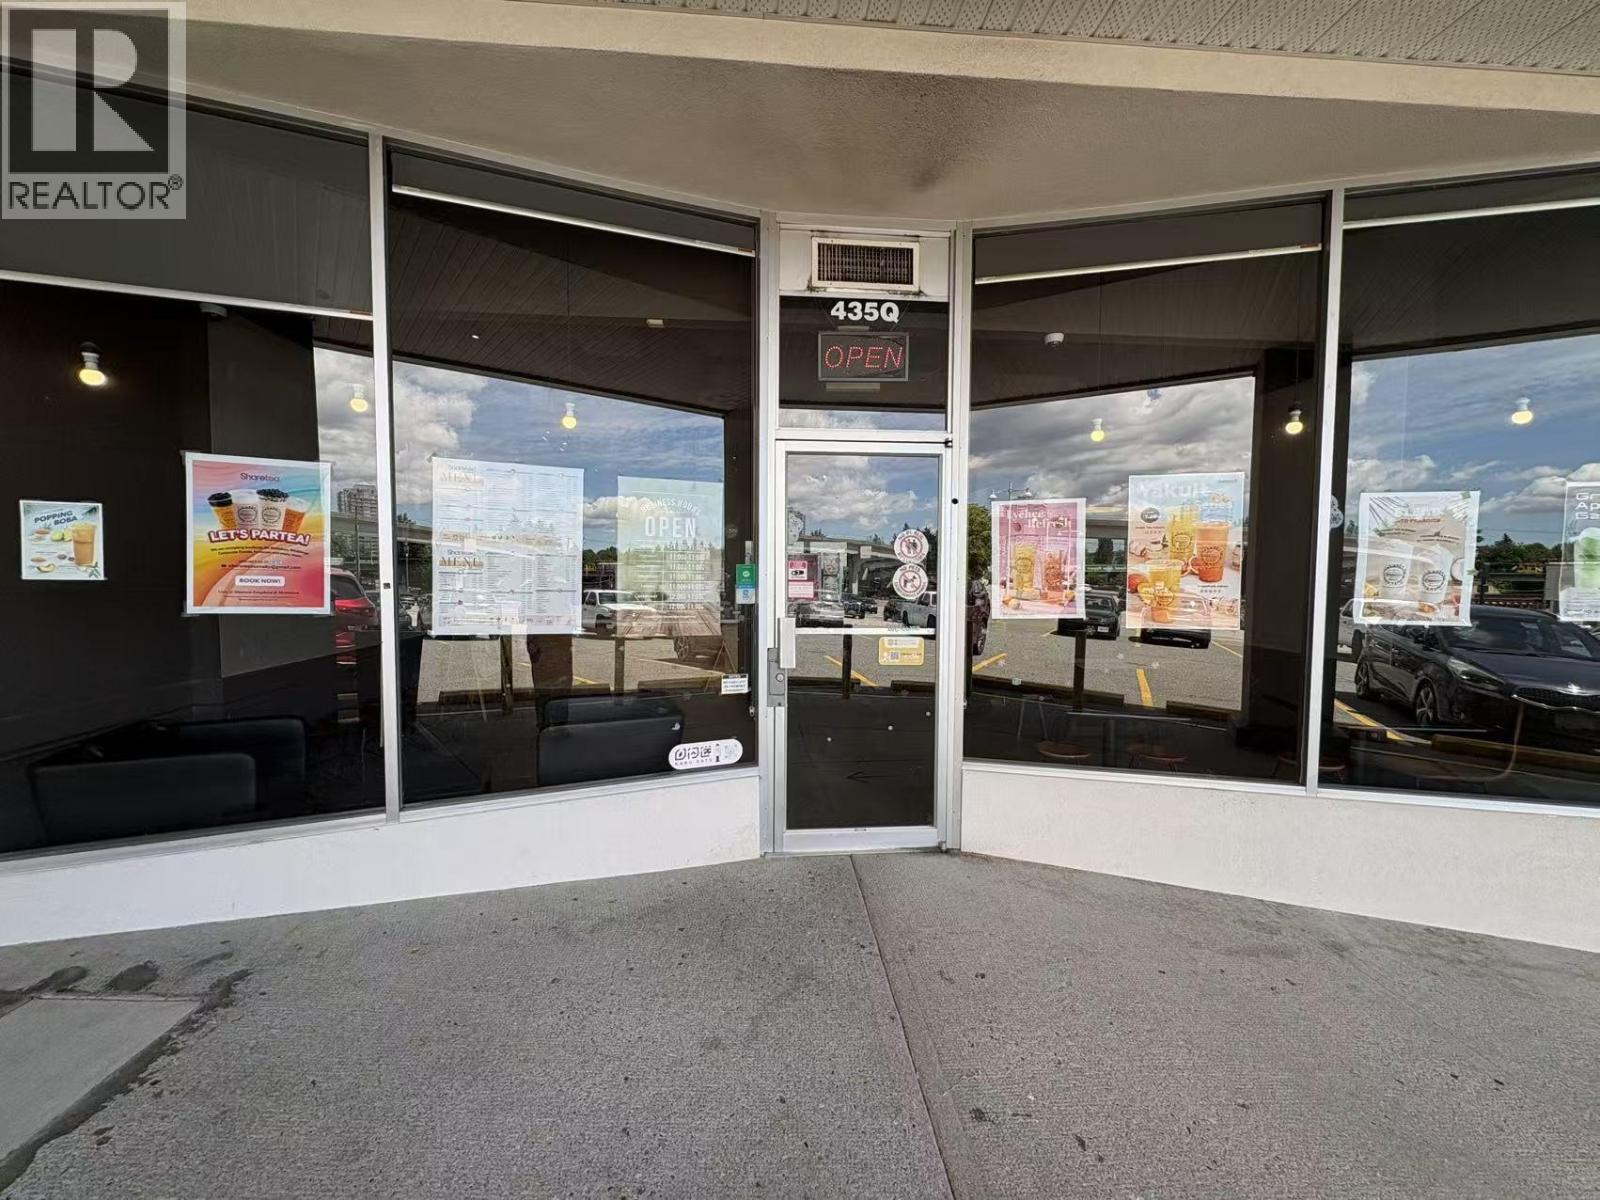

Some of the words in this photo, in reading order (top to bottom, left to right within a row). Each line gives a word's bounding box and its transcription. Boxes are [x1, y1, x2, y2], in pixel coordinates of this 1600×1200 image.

[830, 300, 900, 324] 435Q
[823, 345, 905, 370] OPEN
[240, 472, 281, 482] Sharetea
[34, 510, 74, 524] POPPING
[54, 515, 79, 526] BOBA
[645, 515, 696, 538] OPEN
[209, 529, 249, 543] LET'S
[251, 529, 311, 545] PARTEA!
